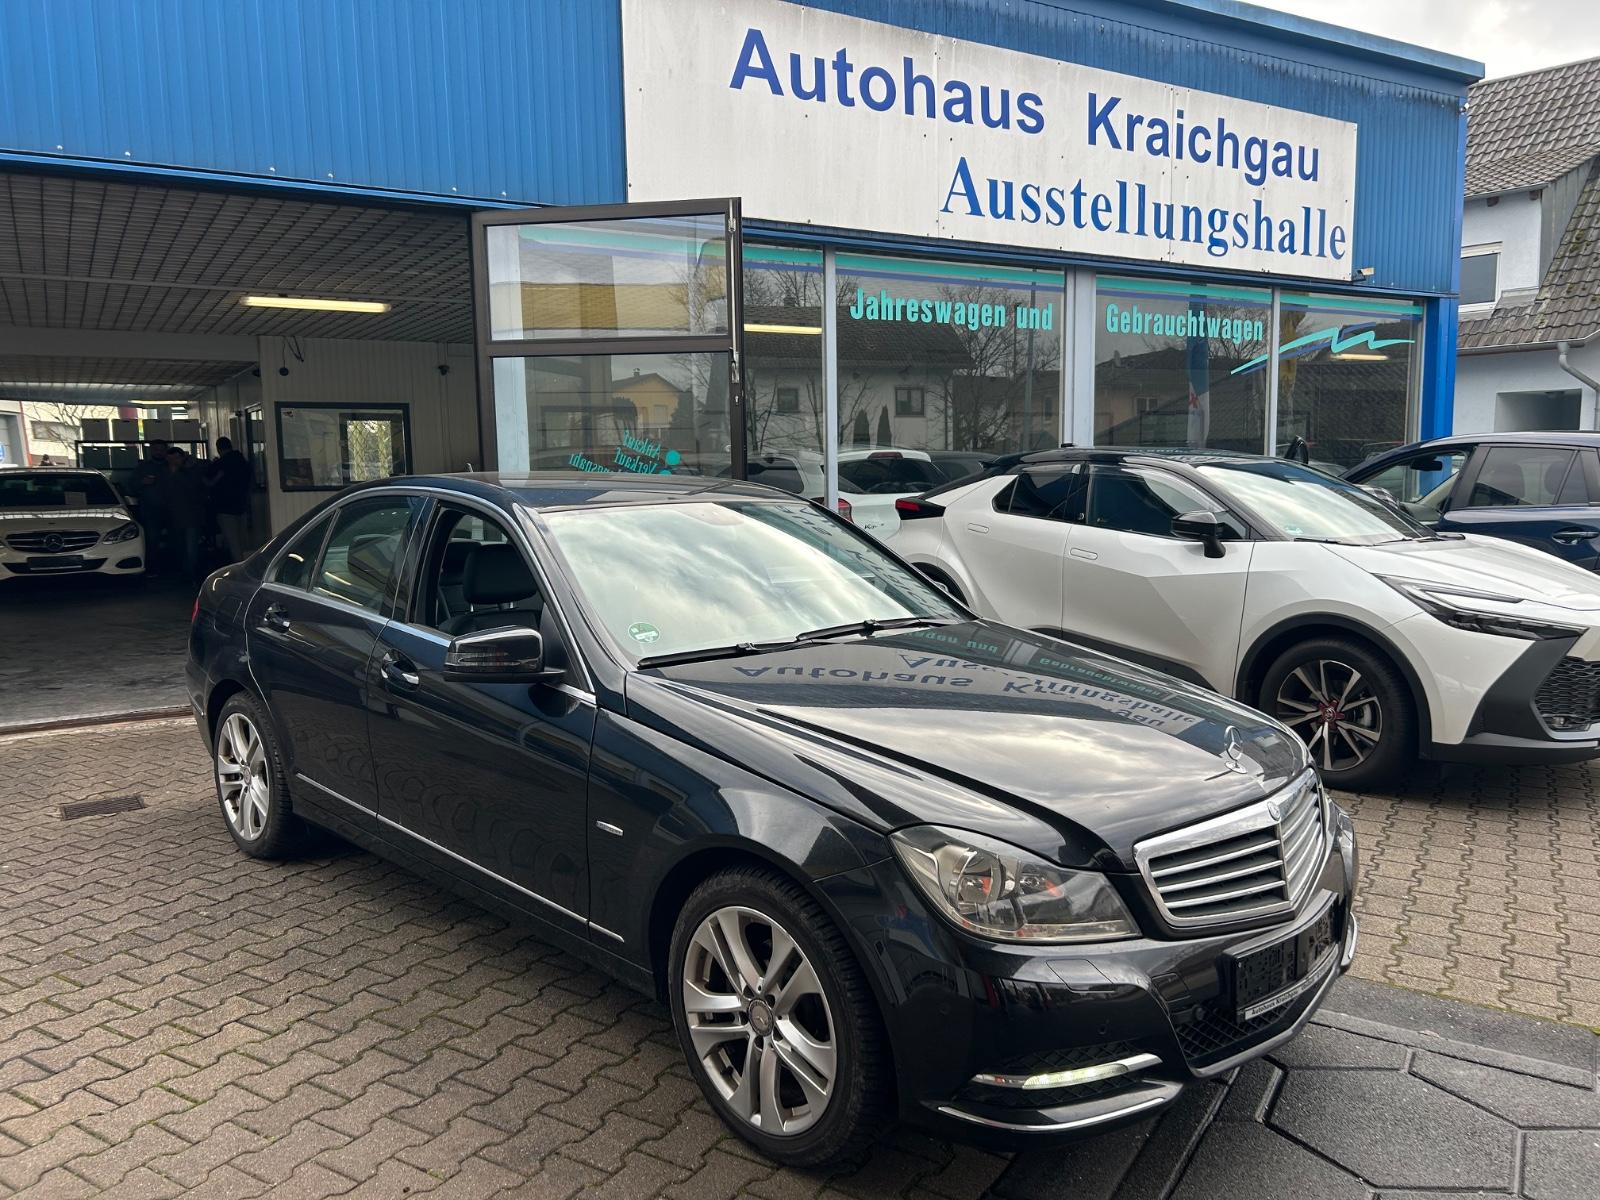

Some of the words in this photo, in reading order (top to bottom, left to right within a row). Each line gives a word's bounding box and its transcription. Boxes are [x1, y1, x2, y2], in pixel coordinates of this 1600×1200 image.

[729, 28, 1046, 134] Autohaus
[1087, 92, 1320, 187] Kraichgau
[941, 156, 1347, 261] Ausstellungshalle
[850, 288, 1006, 331] Jahreswagen
[1016, 303, 1053, 331] und
[1106, 303, 1263, 344] Gebrauchtwagen
